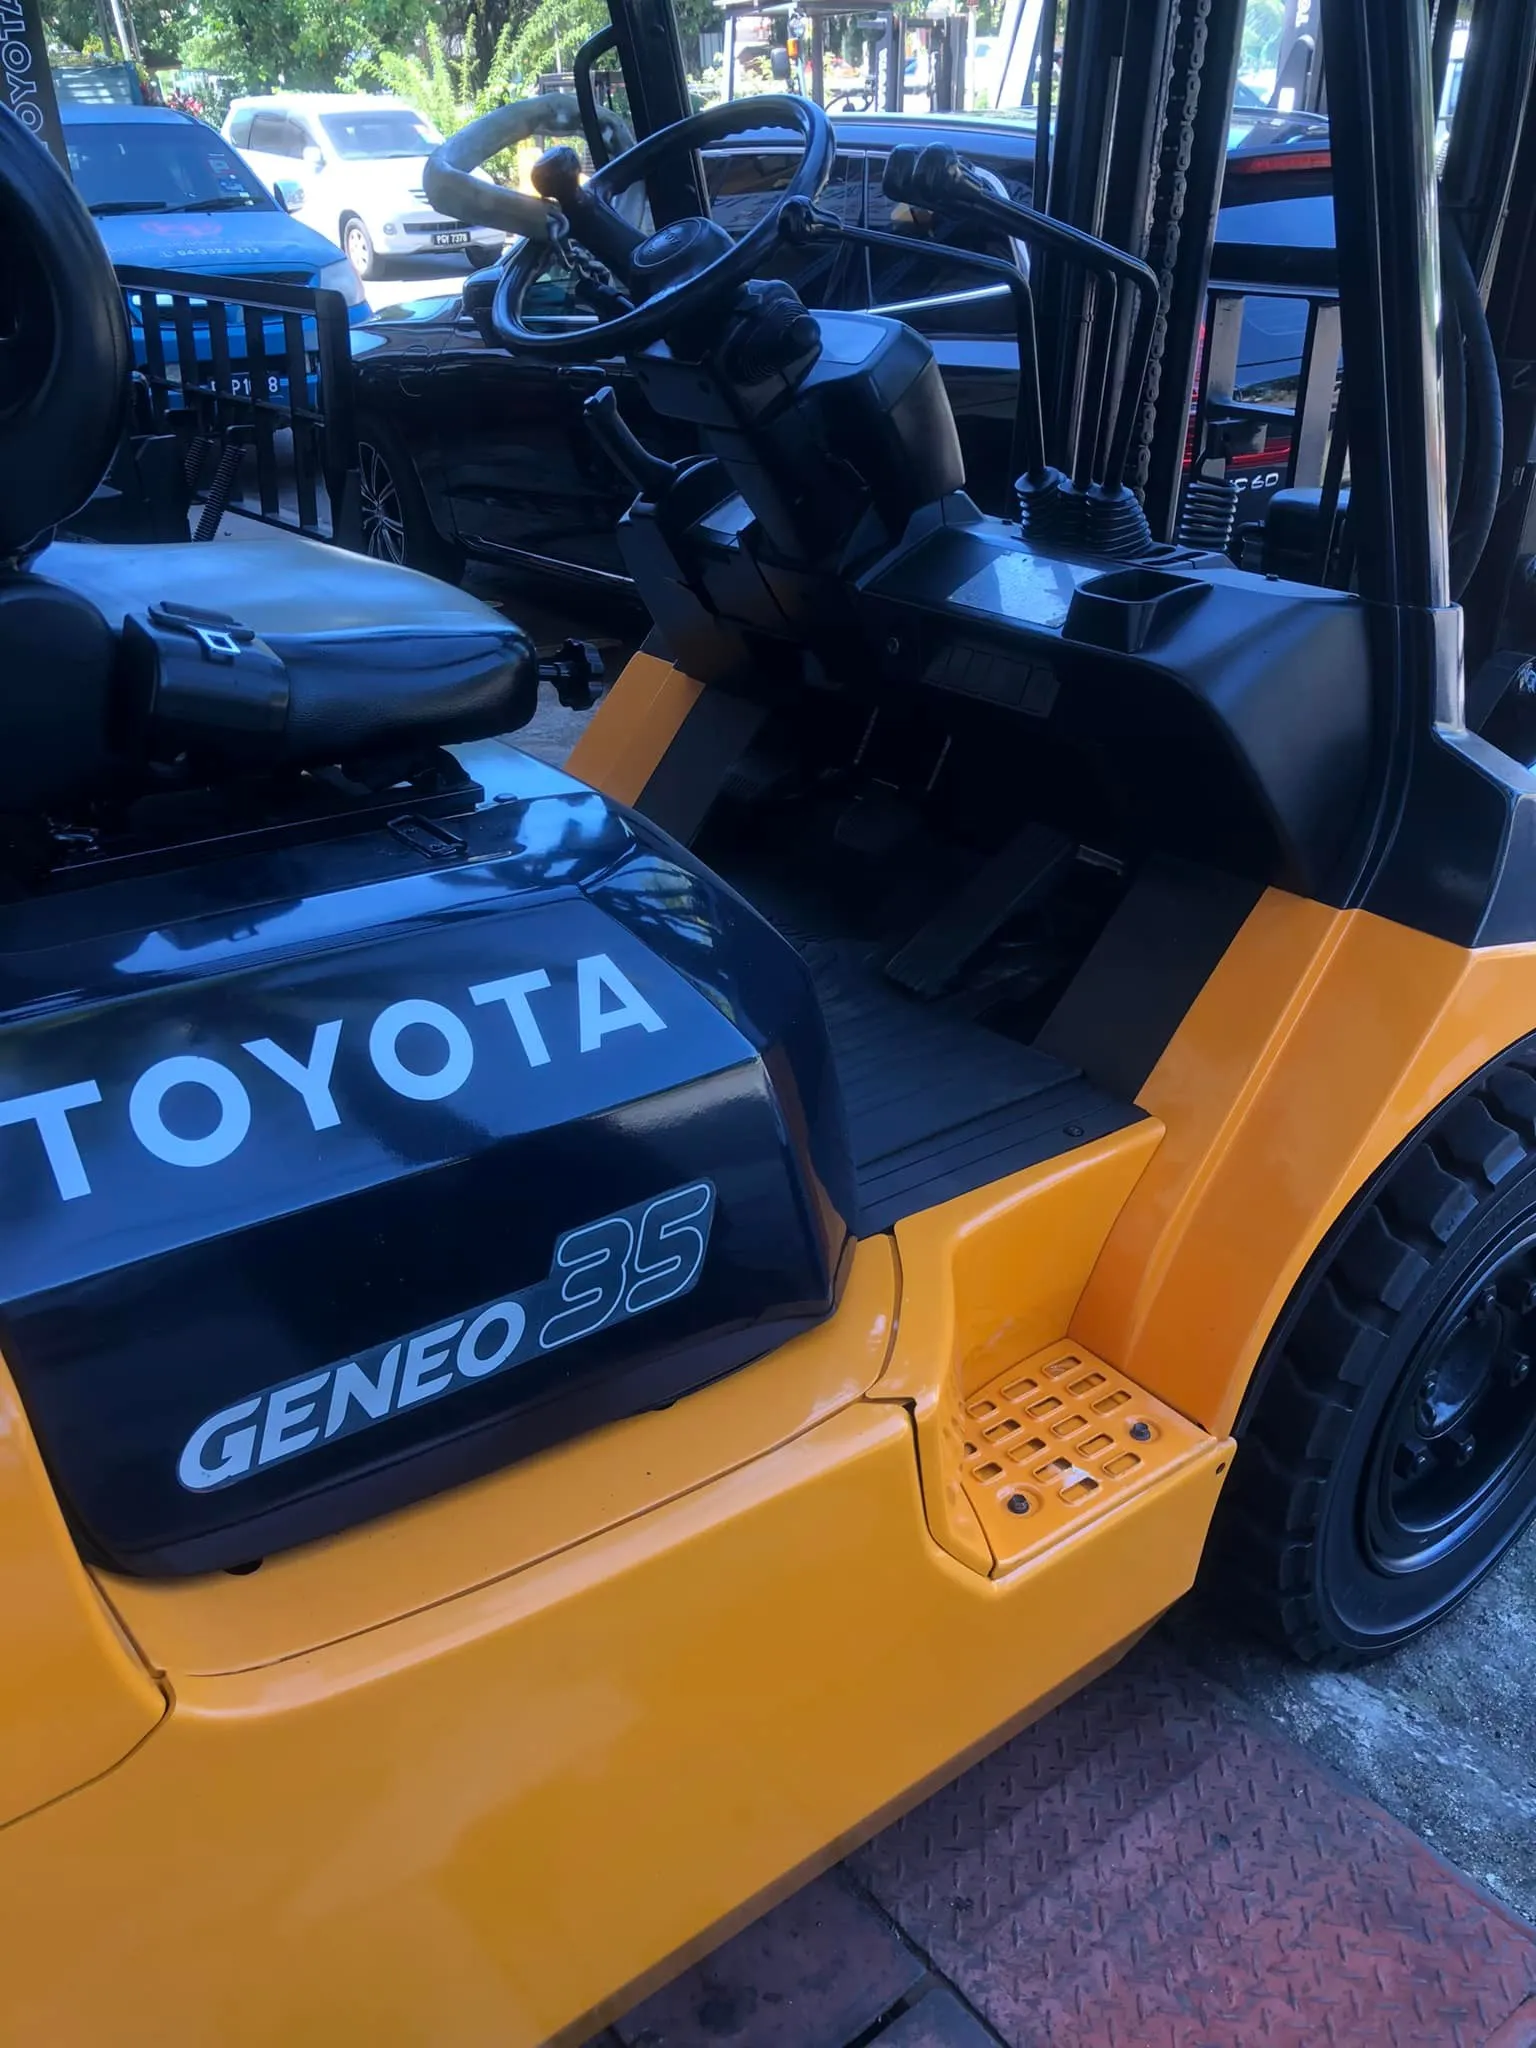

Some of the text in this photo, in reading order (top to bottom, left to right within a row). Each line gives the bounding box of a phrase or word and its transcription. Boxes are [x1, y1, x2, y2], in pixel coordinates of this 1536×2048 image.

[0, 0, 48, 150] OYOT
[0, 953, 667, 1201] TOYOTA
[177, 1184, 711, 1490] GENEO 35
